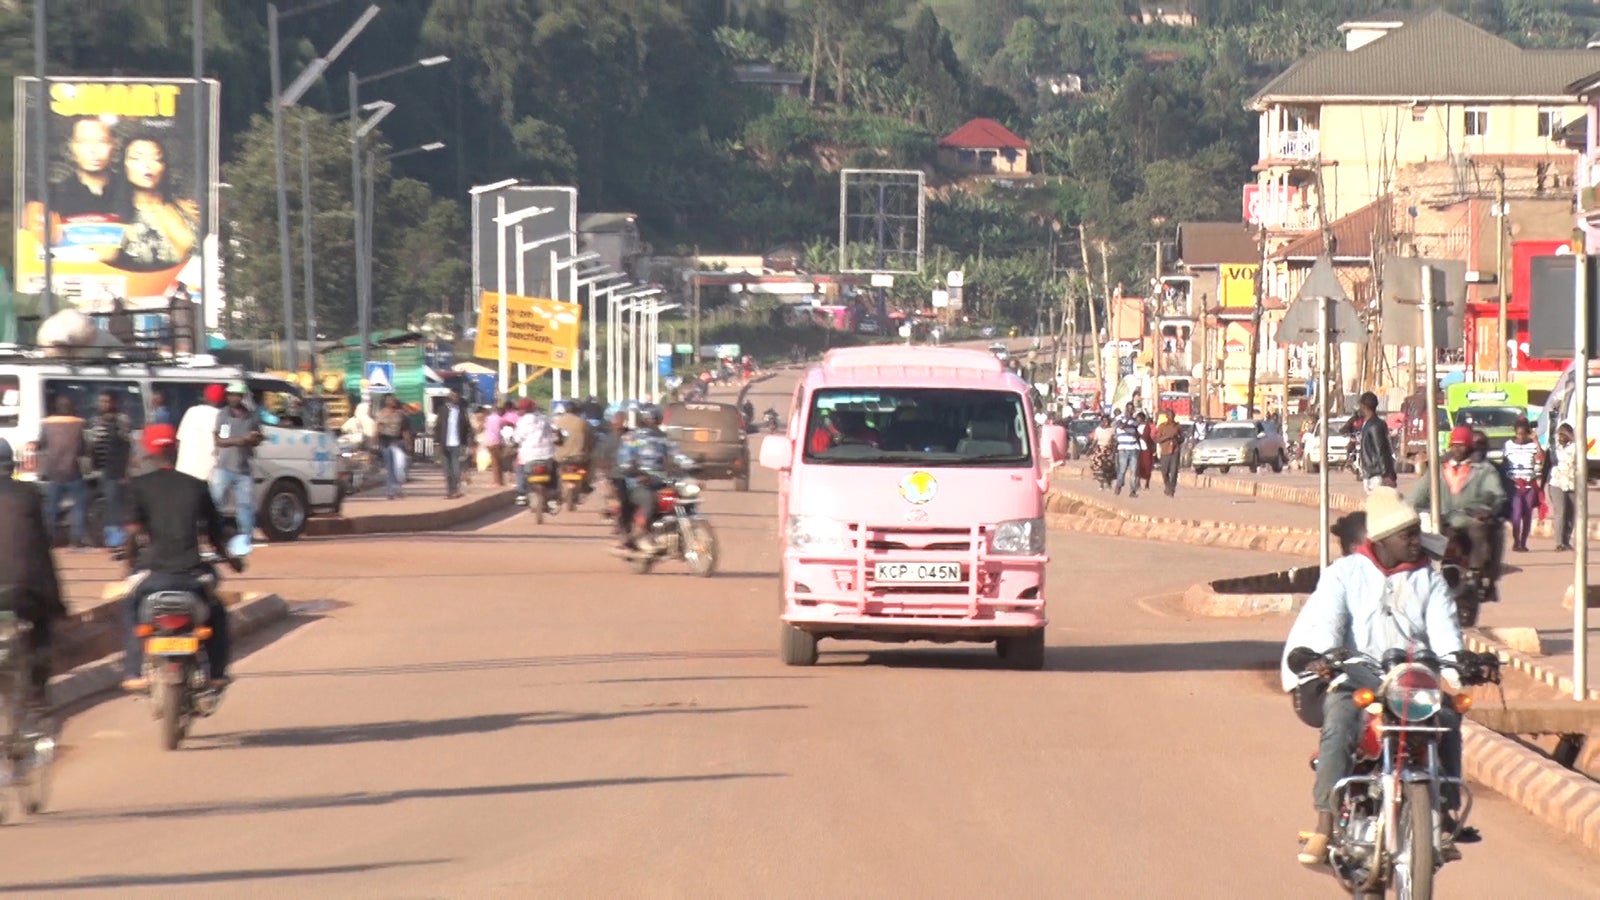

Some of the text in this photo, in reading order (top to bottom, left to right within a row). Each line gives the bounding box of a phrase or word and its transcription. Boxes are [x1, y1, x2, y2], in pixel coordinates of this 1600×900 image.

[1228, 267, 1254, 280] VO
[879, 564, 958, 579] KCP 045N
